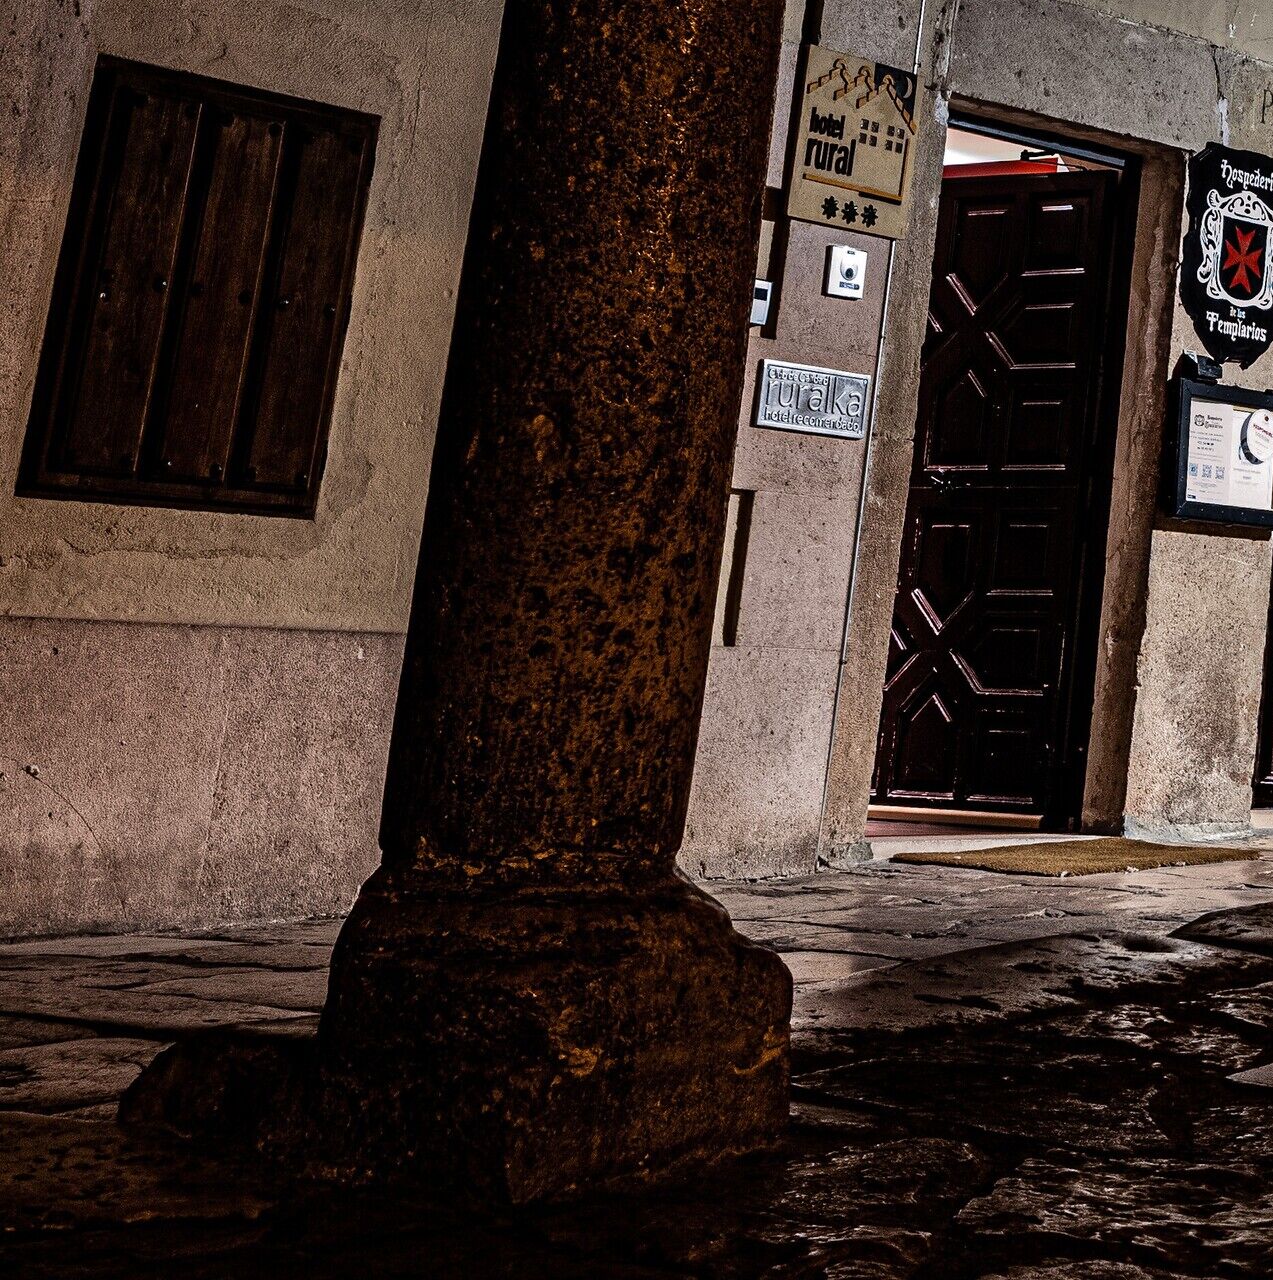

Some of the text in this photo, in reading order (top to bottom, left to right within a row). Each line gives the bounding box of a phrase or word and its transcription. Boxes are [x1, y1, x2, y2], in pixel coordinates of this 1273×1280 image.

[809, 106, 846, 140] hotel
[803, 138, 857, 177] rural
[1206, 310, 1267, 342] Templarios
[766, 375, 862, 418] ruralka
[764, 406, 791, 423] hotel
